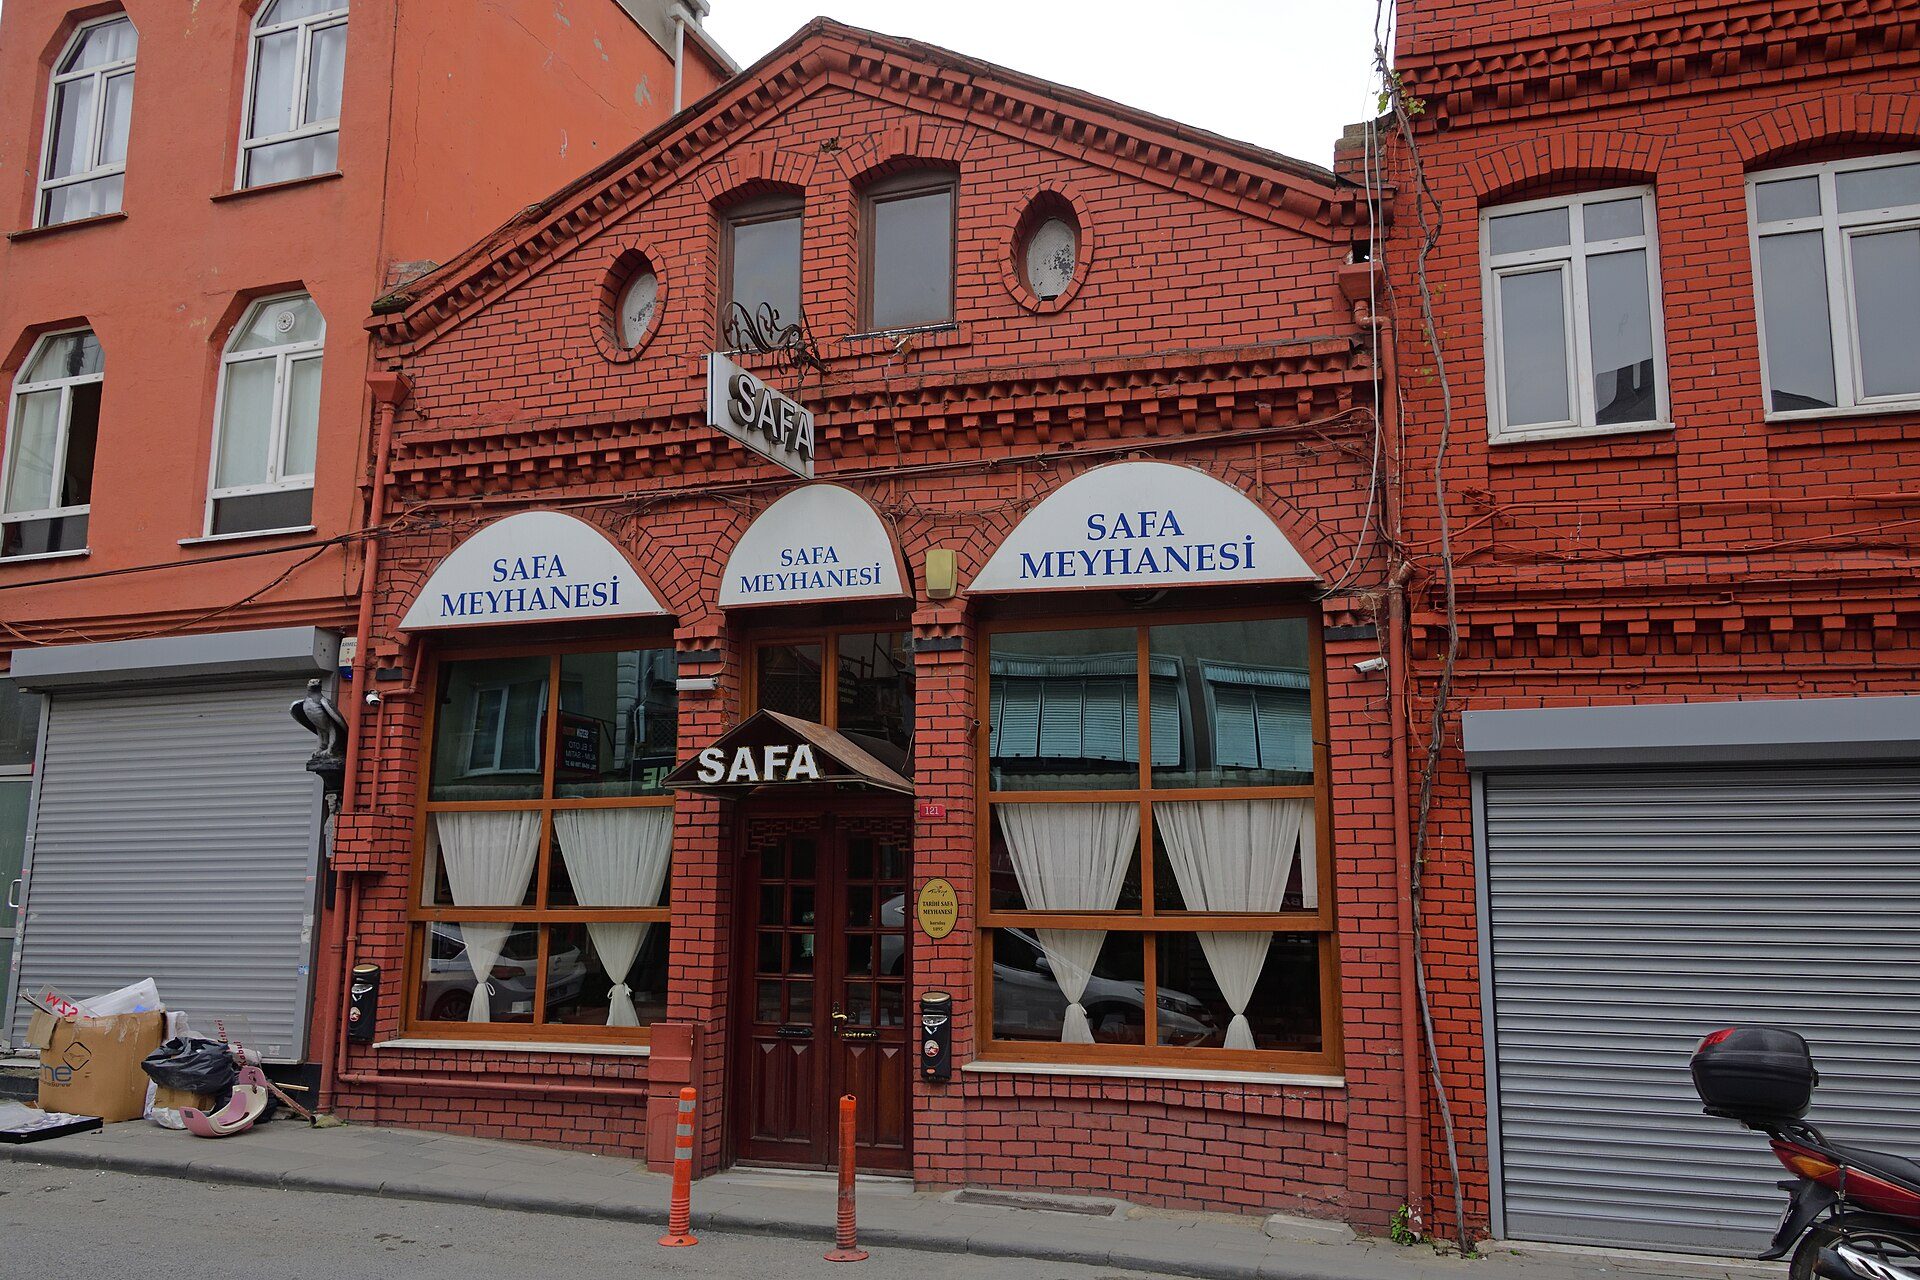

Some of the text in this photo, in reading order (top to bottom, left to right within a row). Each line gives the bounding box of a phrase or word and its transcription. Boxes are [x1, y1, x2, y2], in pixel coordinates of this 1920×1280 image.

[733, 374, 814, 460] SAFA
[1086, 508, 1185, 542] SAFA
[492, 554, 567, 583] SAFA
[780, 545, 840, 568] SAFA
[1019, 534, 1257, 580] MEYHANESİ
[441, 574, 621, 617] MEYHANESİ
[740, 565, 882, 593] MEYHANESİ
[697, 744, 820, 784] SAFA
[925, 806, 939, 815] 121
